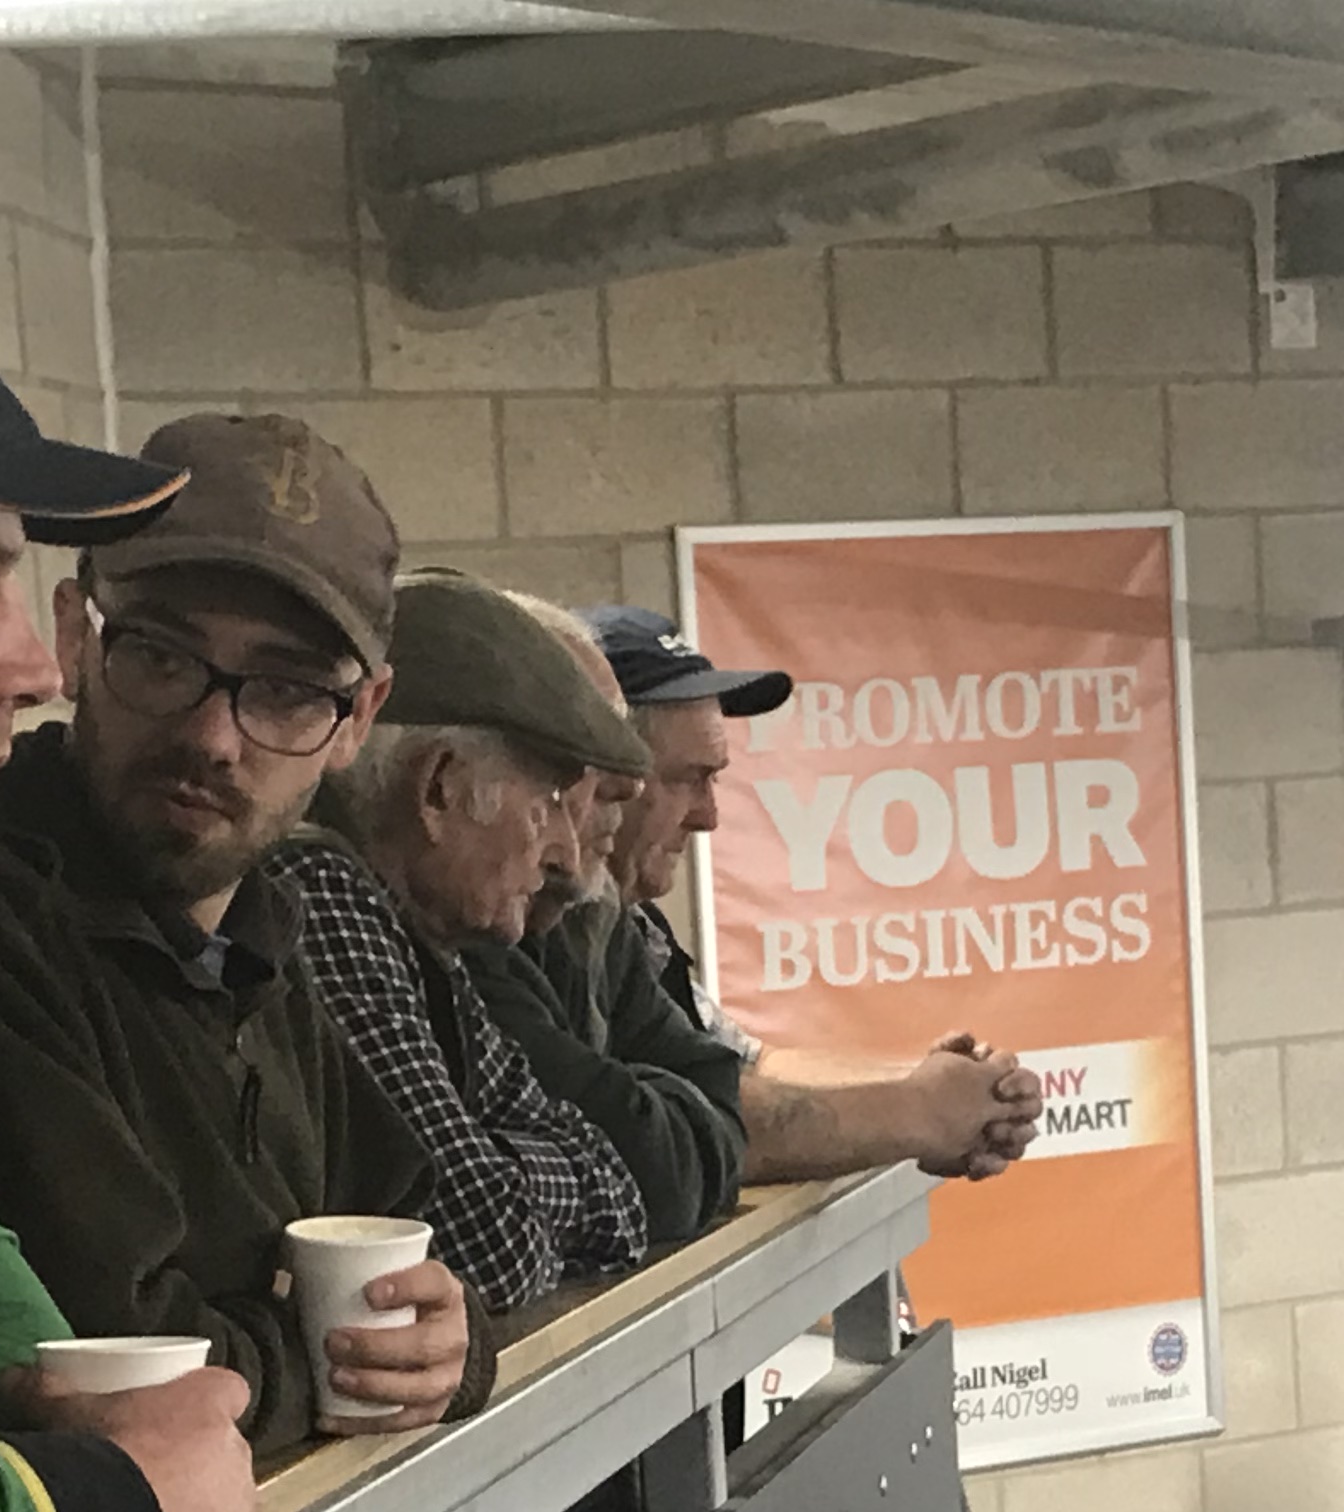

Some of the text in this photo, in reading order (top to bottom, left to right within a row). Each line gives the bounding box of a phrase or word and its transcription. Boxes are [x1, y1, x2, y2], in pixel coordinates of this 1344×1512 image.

[754, 759, 1147, 892] YOUR
[757, 893, 1152, 992] BUSINESS
[1046, 1098, 1133, 1136] MART
[990, 1357, 1049, 1390] Nigel
[990, 1383, 1079, 1421] 407999
